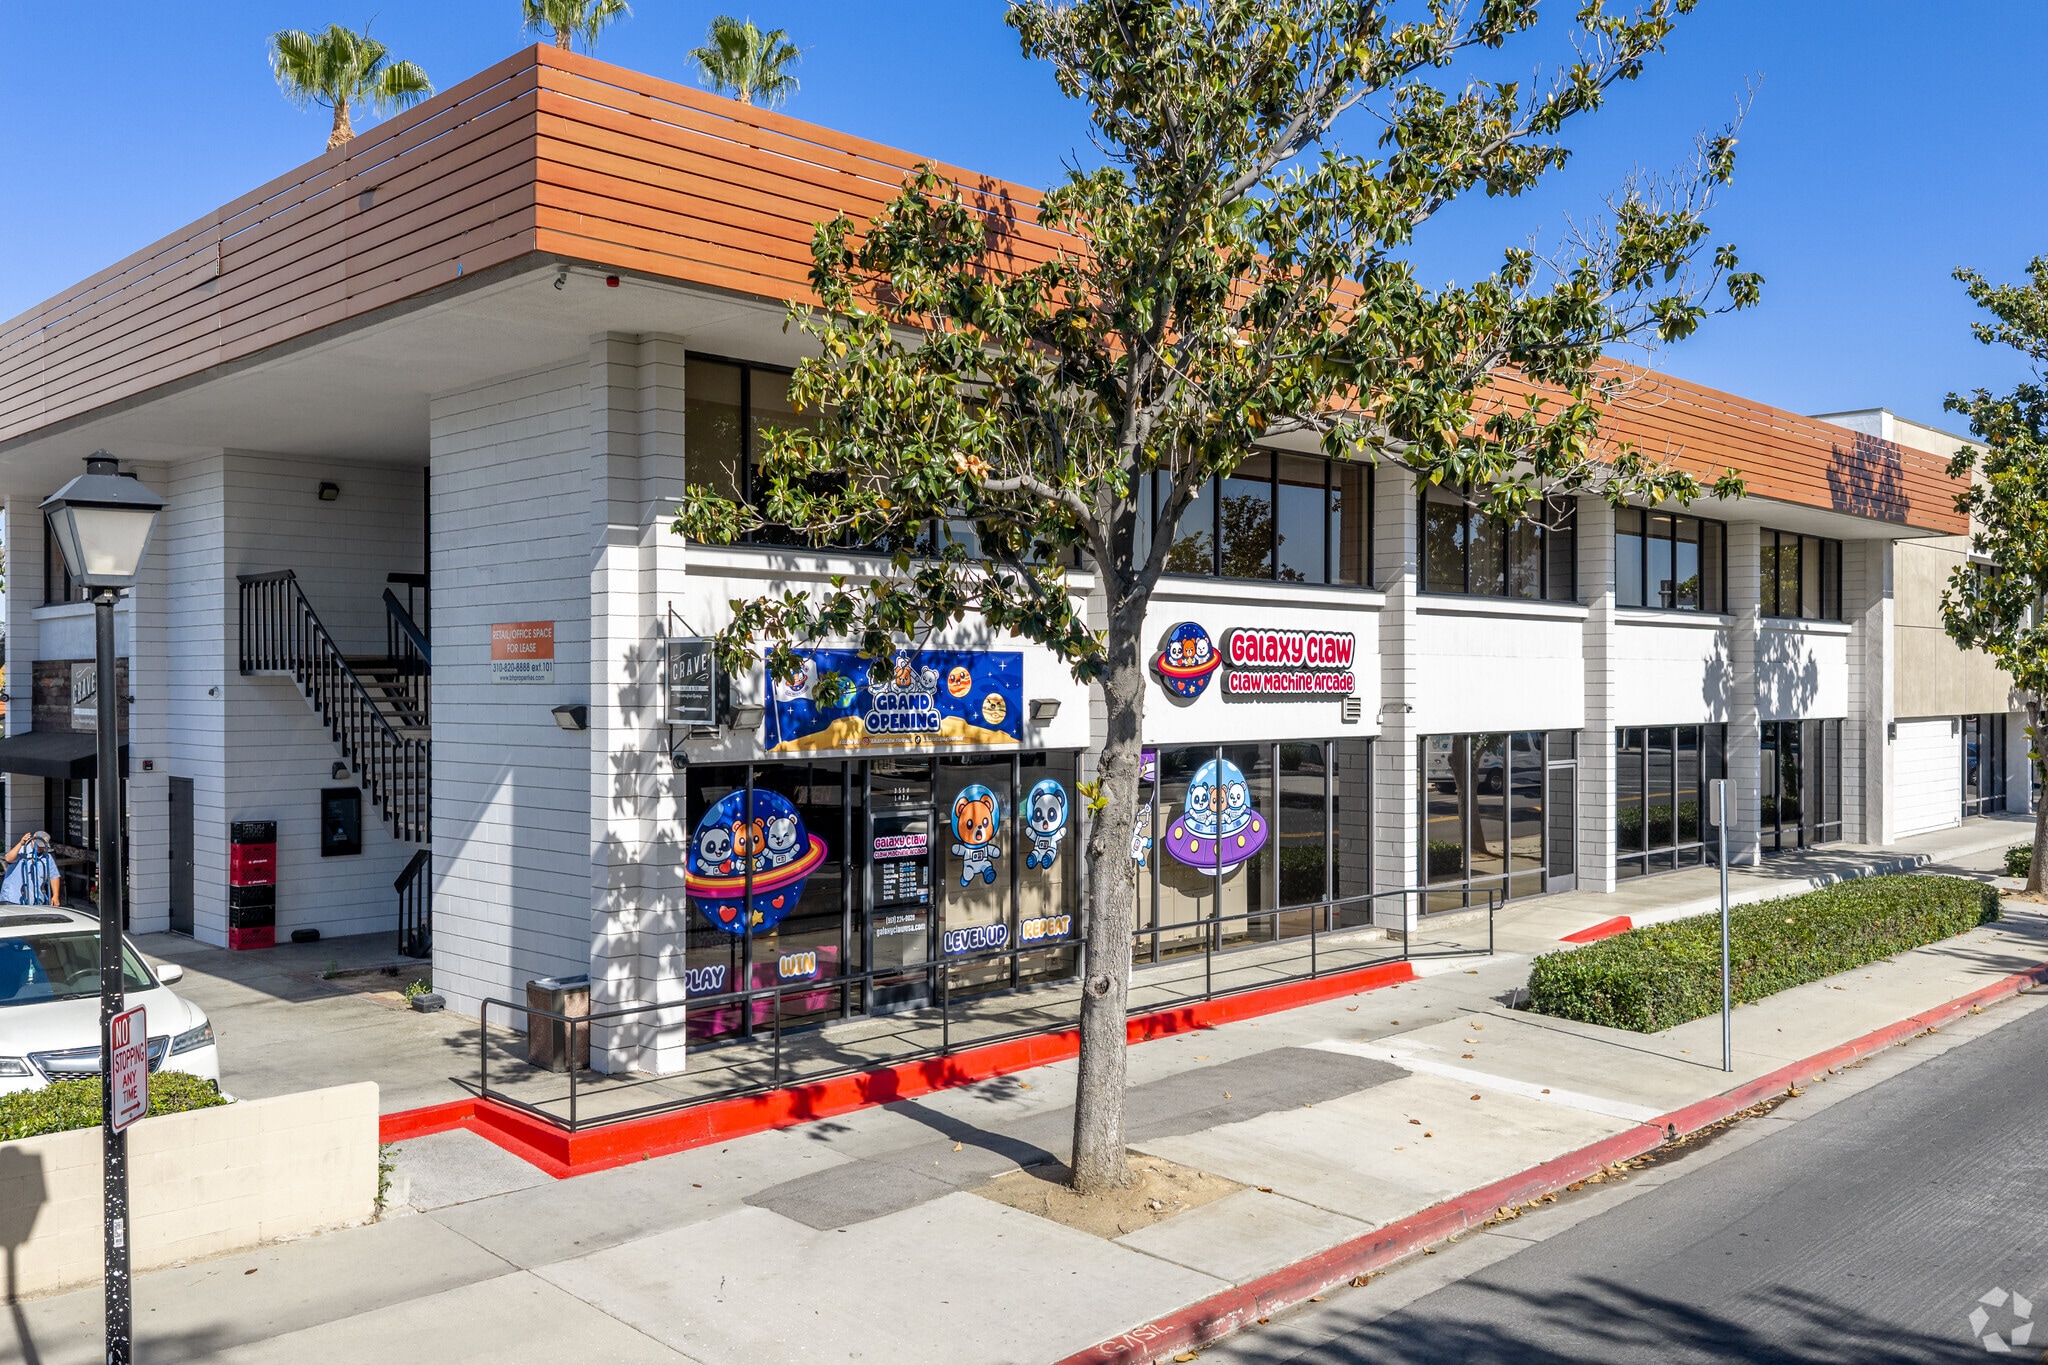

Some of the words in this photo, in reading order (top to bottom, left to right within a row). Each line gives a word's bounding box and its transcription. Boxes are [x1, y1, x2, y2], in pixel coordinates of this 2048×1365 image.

[493, 628, 532, 640] RETAIL/OFFICE
[532, 627, 552, 639] SPACE
[507, 643, 519, 653] FOR
[520, 642, 537, 653] LEASE
[1231, 633, 1303, 664] Galaxy
[672, 653, 707, 681] CRAVE
[875, 692, 931, 711] GRAND
[866, 712, 939, 731] OPENING
[875, 836, 905, 849] Galaxy
[906, 834, 927, 847] Claw
[944, 926, 986, 952] LEVEL
[986, 924, 1007, 946] UP
[1023, 915, 1071, 940] REPEAT
[779, 951, 817, 978] WIN
[115, 1017, 128, 1047] NO
[115, 1042, 145, 1074] STOPPING
[122, 1069, 137, 1088] ANY
[123, 1085, 138, 1104] TIME
